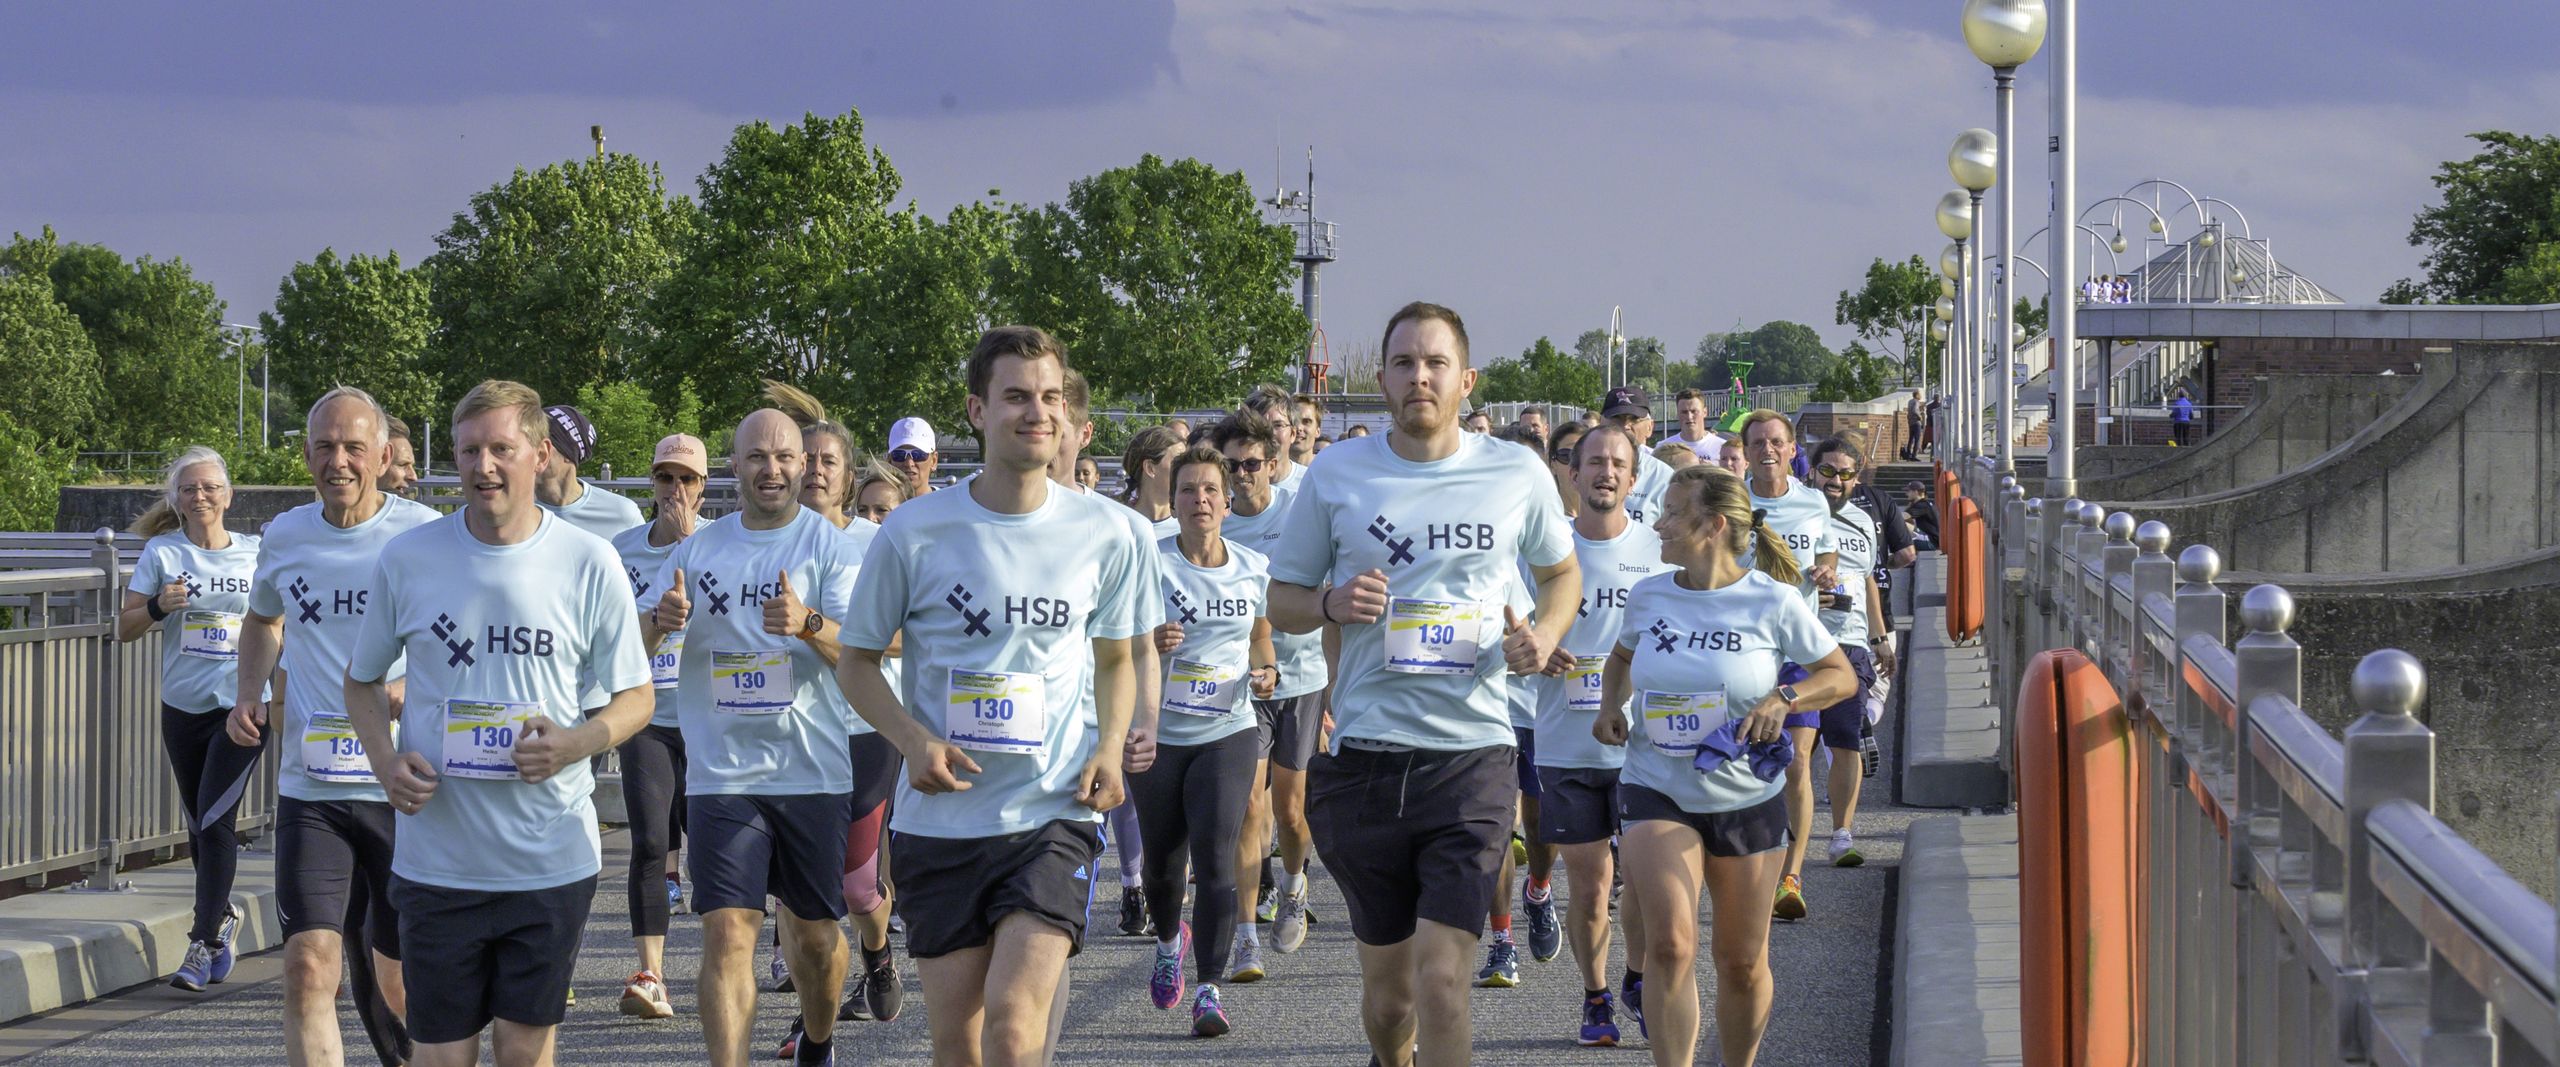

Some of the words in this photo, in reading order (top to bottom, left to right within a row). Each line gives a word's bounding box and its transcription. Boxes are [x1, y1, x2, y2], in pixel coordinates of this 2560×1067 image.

[1428, 523, 1495, 550] HSB
[1782, 534, 1810, 549] SB
[1838, 537, 1867, 553] HSB
[1619, 563, 1651, 573] Dennis
[211, 577, 250, 593] HSB
[334, 590, 368, 615] HS
[1597, 588, 1629, 608] HS
[1005, 595, 1070, 628] HSB
[1206, 599, 1248, 617] HSB
[202, 626, 228, 642] 130
[488, 625, 554, 657] HSB
[1419, 623, 1455, 645] 130
[1687, 631, 1743, 652] HSB
[651, 653, 676, 668] 130
[731, 671, 766, 689] 130
[1190, 680, 1217, 696] 130
[1582, 673, 1601, 688] 13
[972, 697, 1014, 720] 130
[1665, 713, 1700, 731] 130
[472, 725, 513, 748] 130
[330, 736, 366, 756] 130
